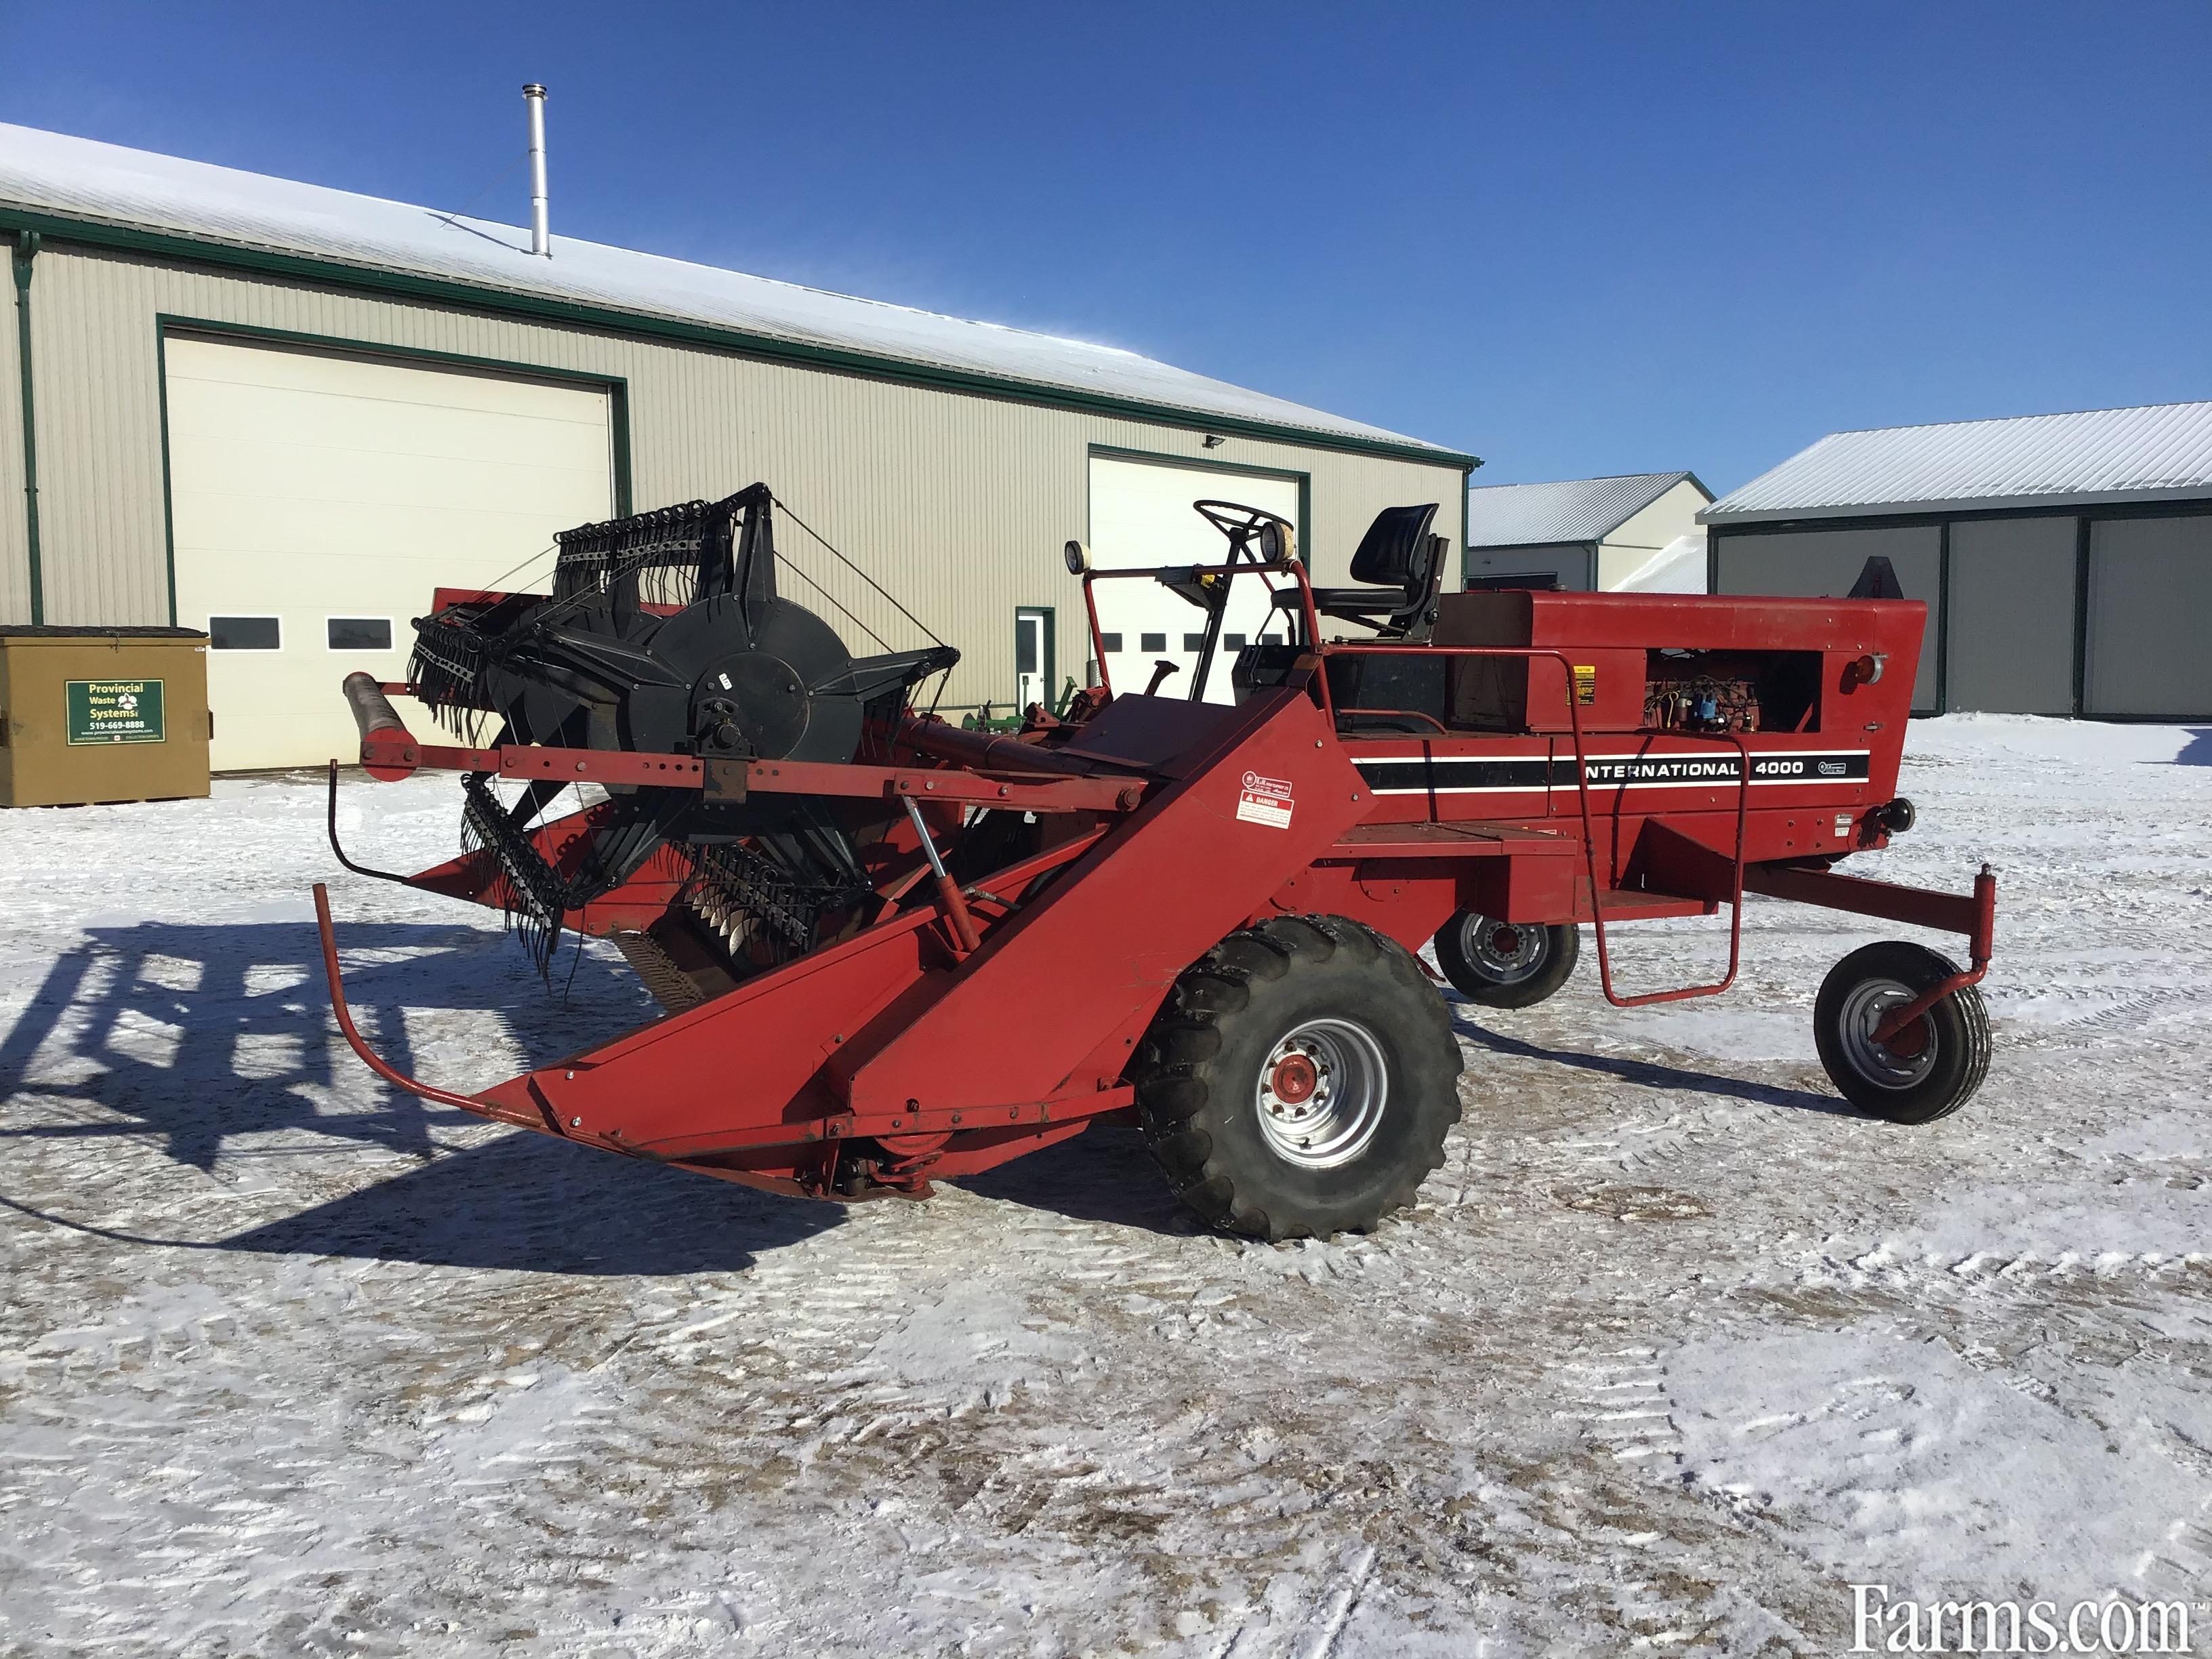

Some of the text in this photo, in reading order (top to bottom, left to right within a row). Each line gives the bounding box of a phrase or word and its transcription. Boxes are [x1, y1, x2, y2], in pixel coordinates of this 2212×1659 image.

[89, 683, 144, 693] Provincial
[89, 697, 116, 705] Waste
[89, 708, 135, 720] Systems
[89, 720, 144, 730] 519-669-8888
[1584, 762, 1803, 779] NTERNATIONAL 4000
[1256, 797, 1278, 806] DANGER
